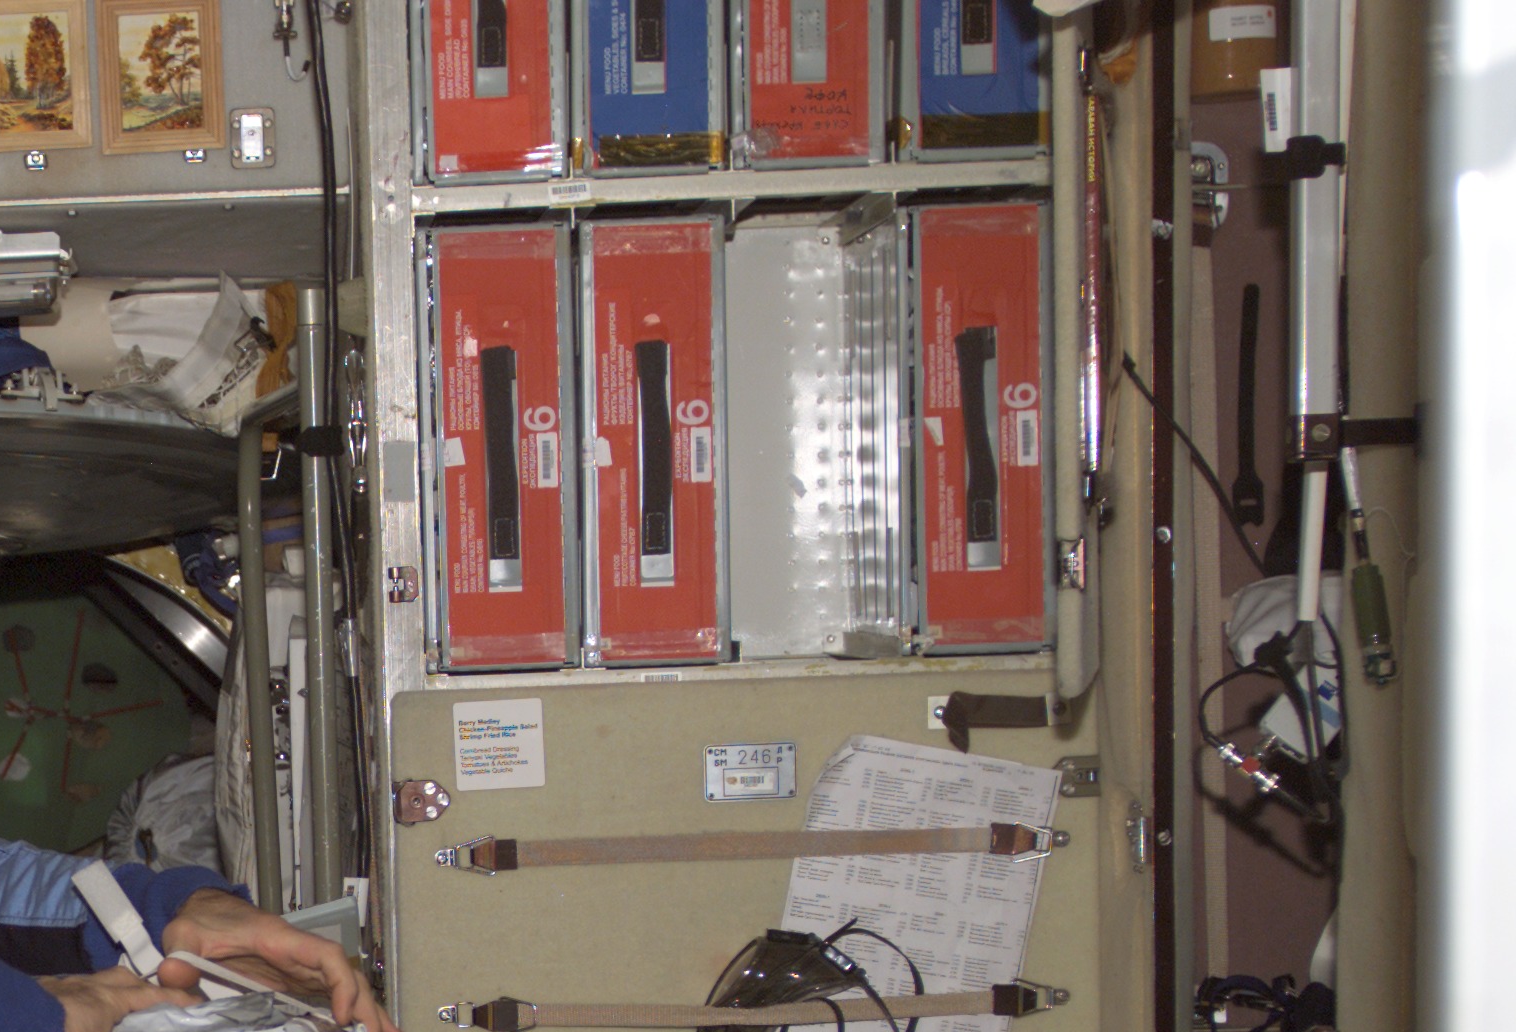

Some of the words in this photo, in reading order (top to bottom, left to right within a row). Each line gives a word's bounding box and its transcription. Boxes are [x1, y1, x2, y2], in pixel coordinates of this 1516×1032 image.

[462, 54, 470, 98] CONTAINER
[619, 49, 628, 94] CONTAINER
[1004, 382, 1037, 408] 6
[524, 406, 556, 431] 6
[676, 399, 709, 425] 6
[1009, 410, 1017, 466] ЭКСПЕДИЦИЯ
[738, 749, 770, 765] 246
